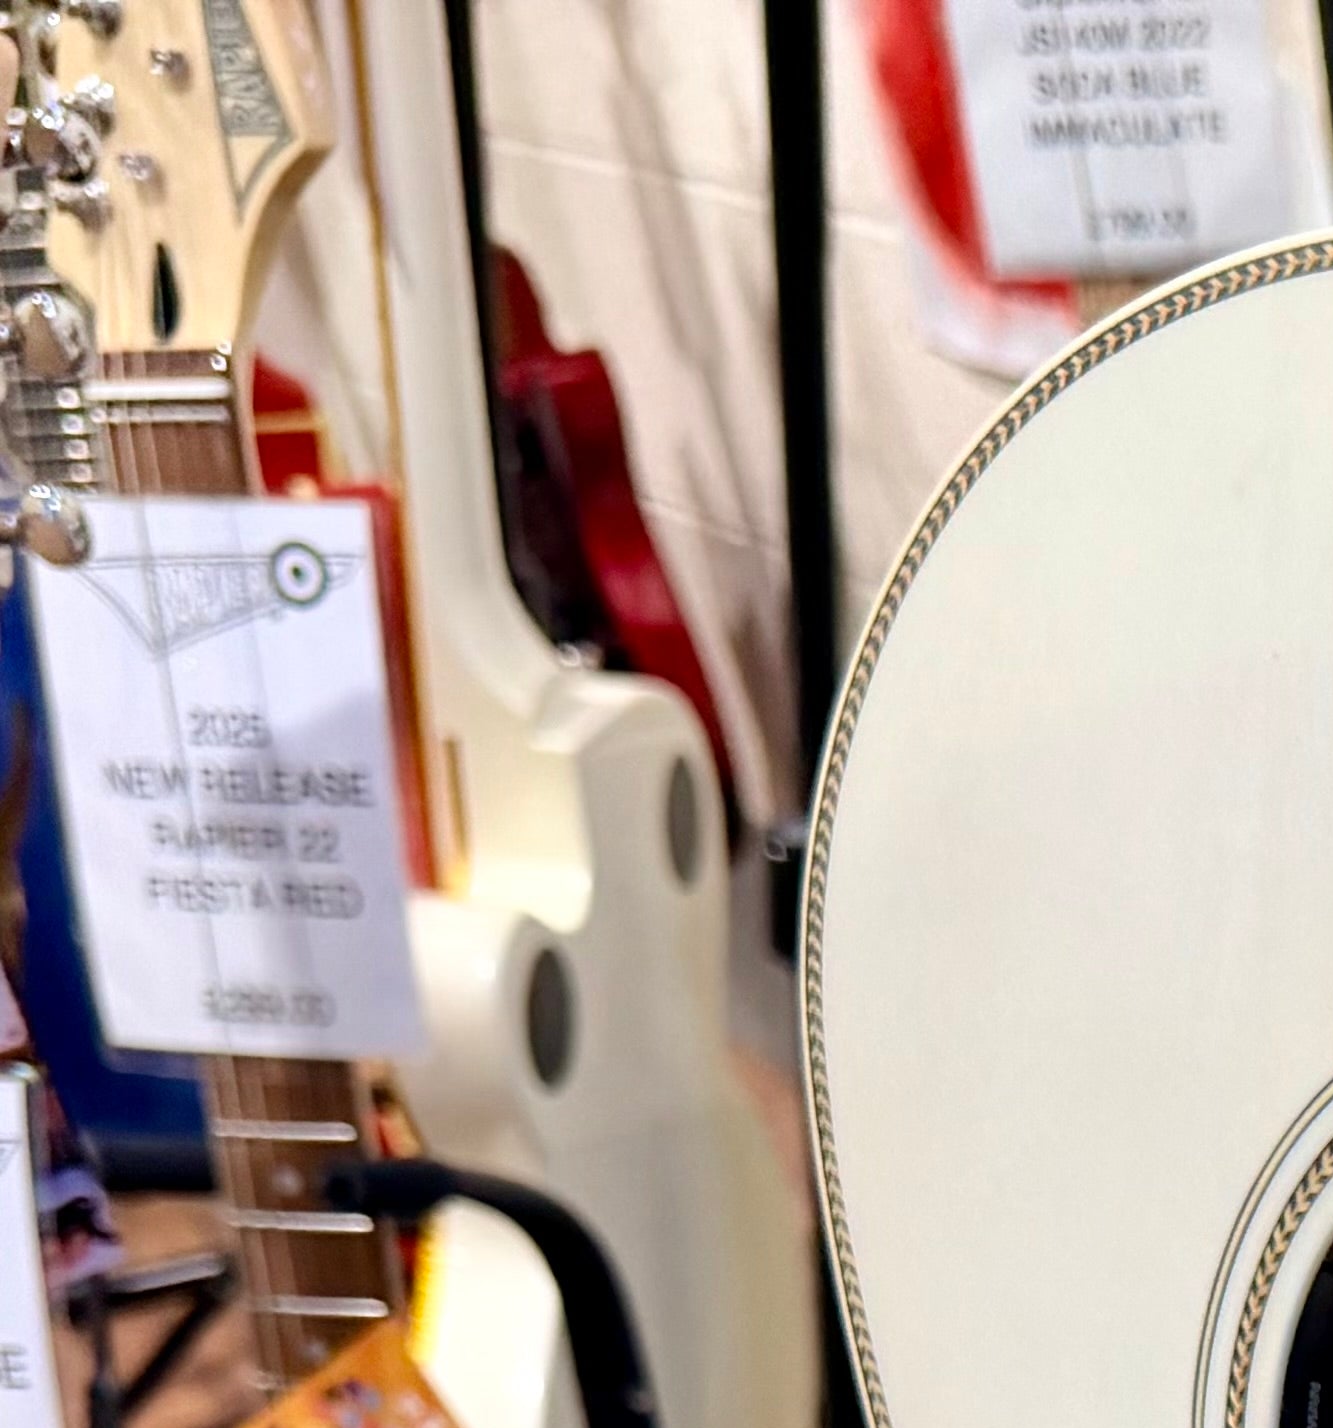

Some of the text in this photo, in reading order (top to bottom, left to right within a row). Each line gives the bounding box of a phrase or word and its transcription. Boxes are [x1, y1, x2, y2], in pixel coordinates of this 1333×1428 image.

[1125, 59, 1207, 101] BLUE
[104, 759, 376, 807] NEW RELEASE
[284, 876, 365, 920] RED
